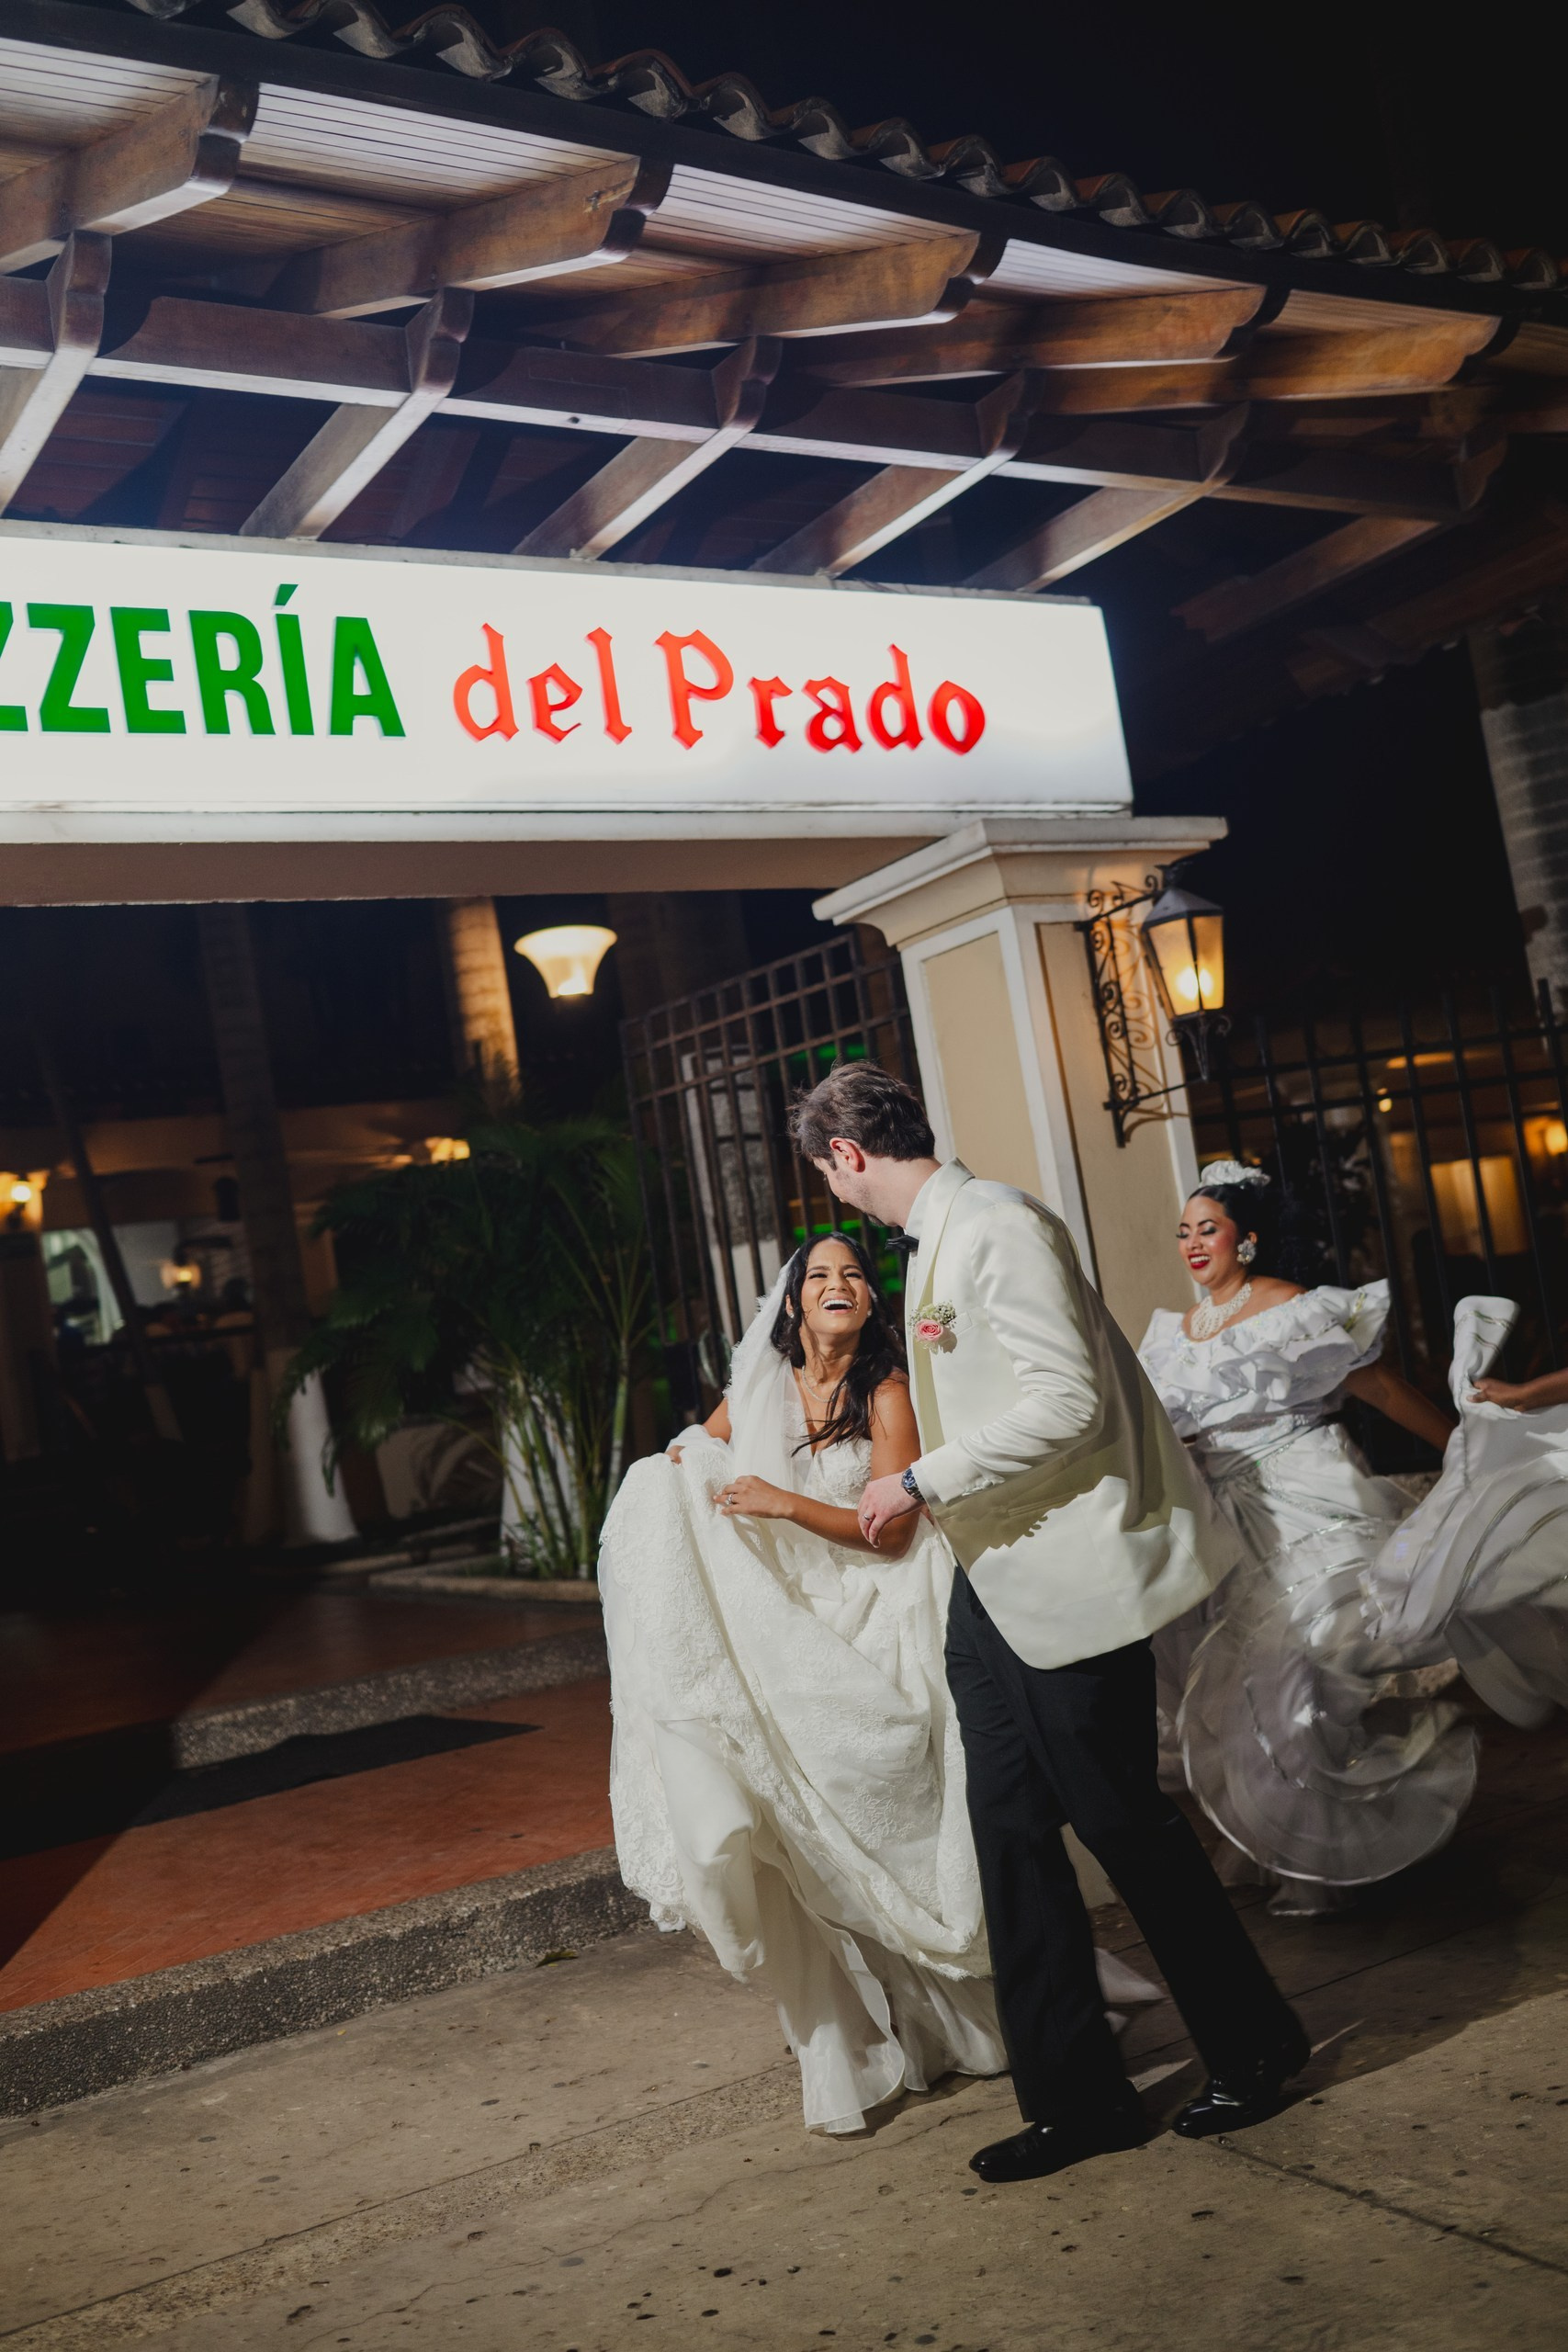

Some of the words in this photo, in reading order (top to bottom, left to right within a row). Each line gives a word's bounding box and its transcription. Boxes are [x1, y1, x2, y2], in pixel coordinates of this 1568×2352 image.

[0, 583, 406, 738] ZERÍA
[453, 622, 633, 745] del
[653, 628, 987, 756] Prado
